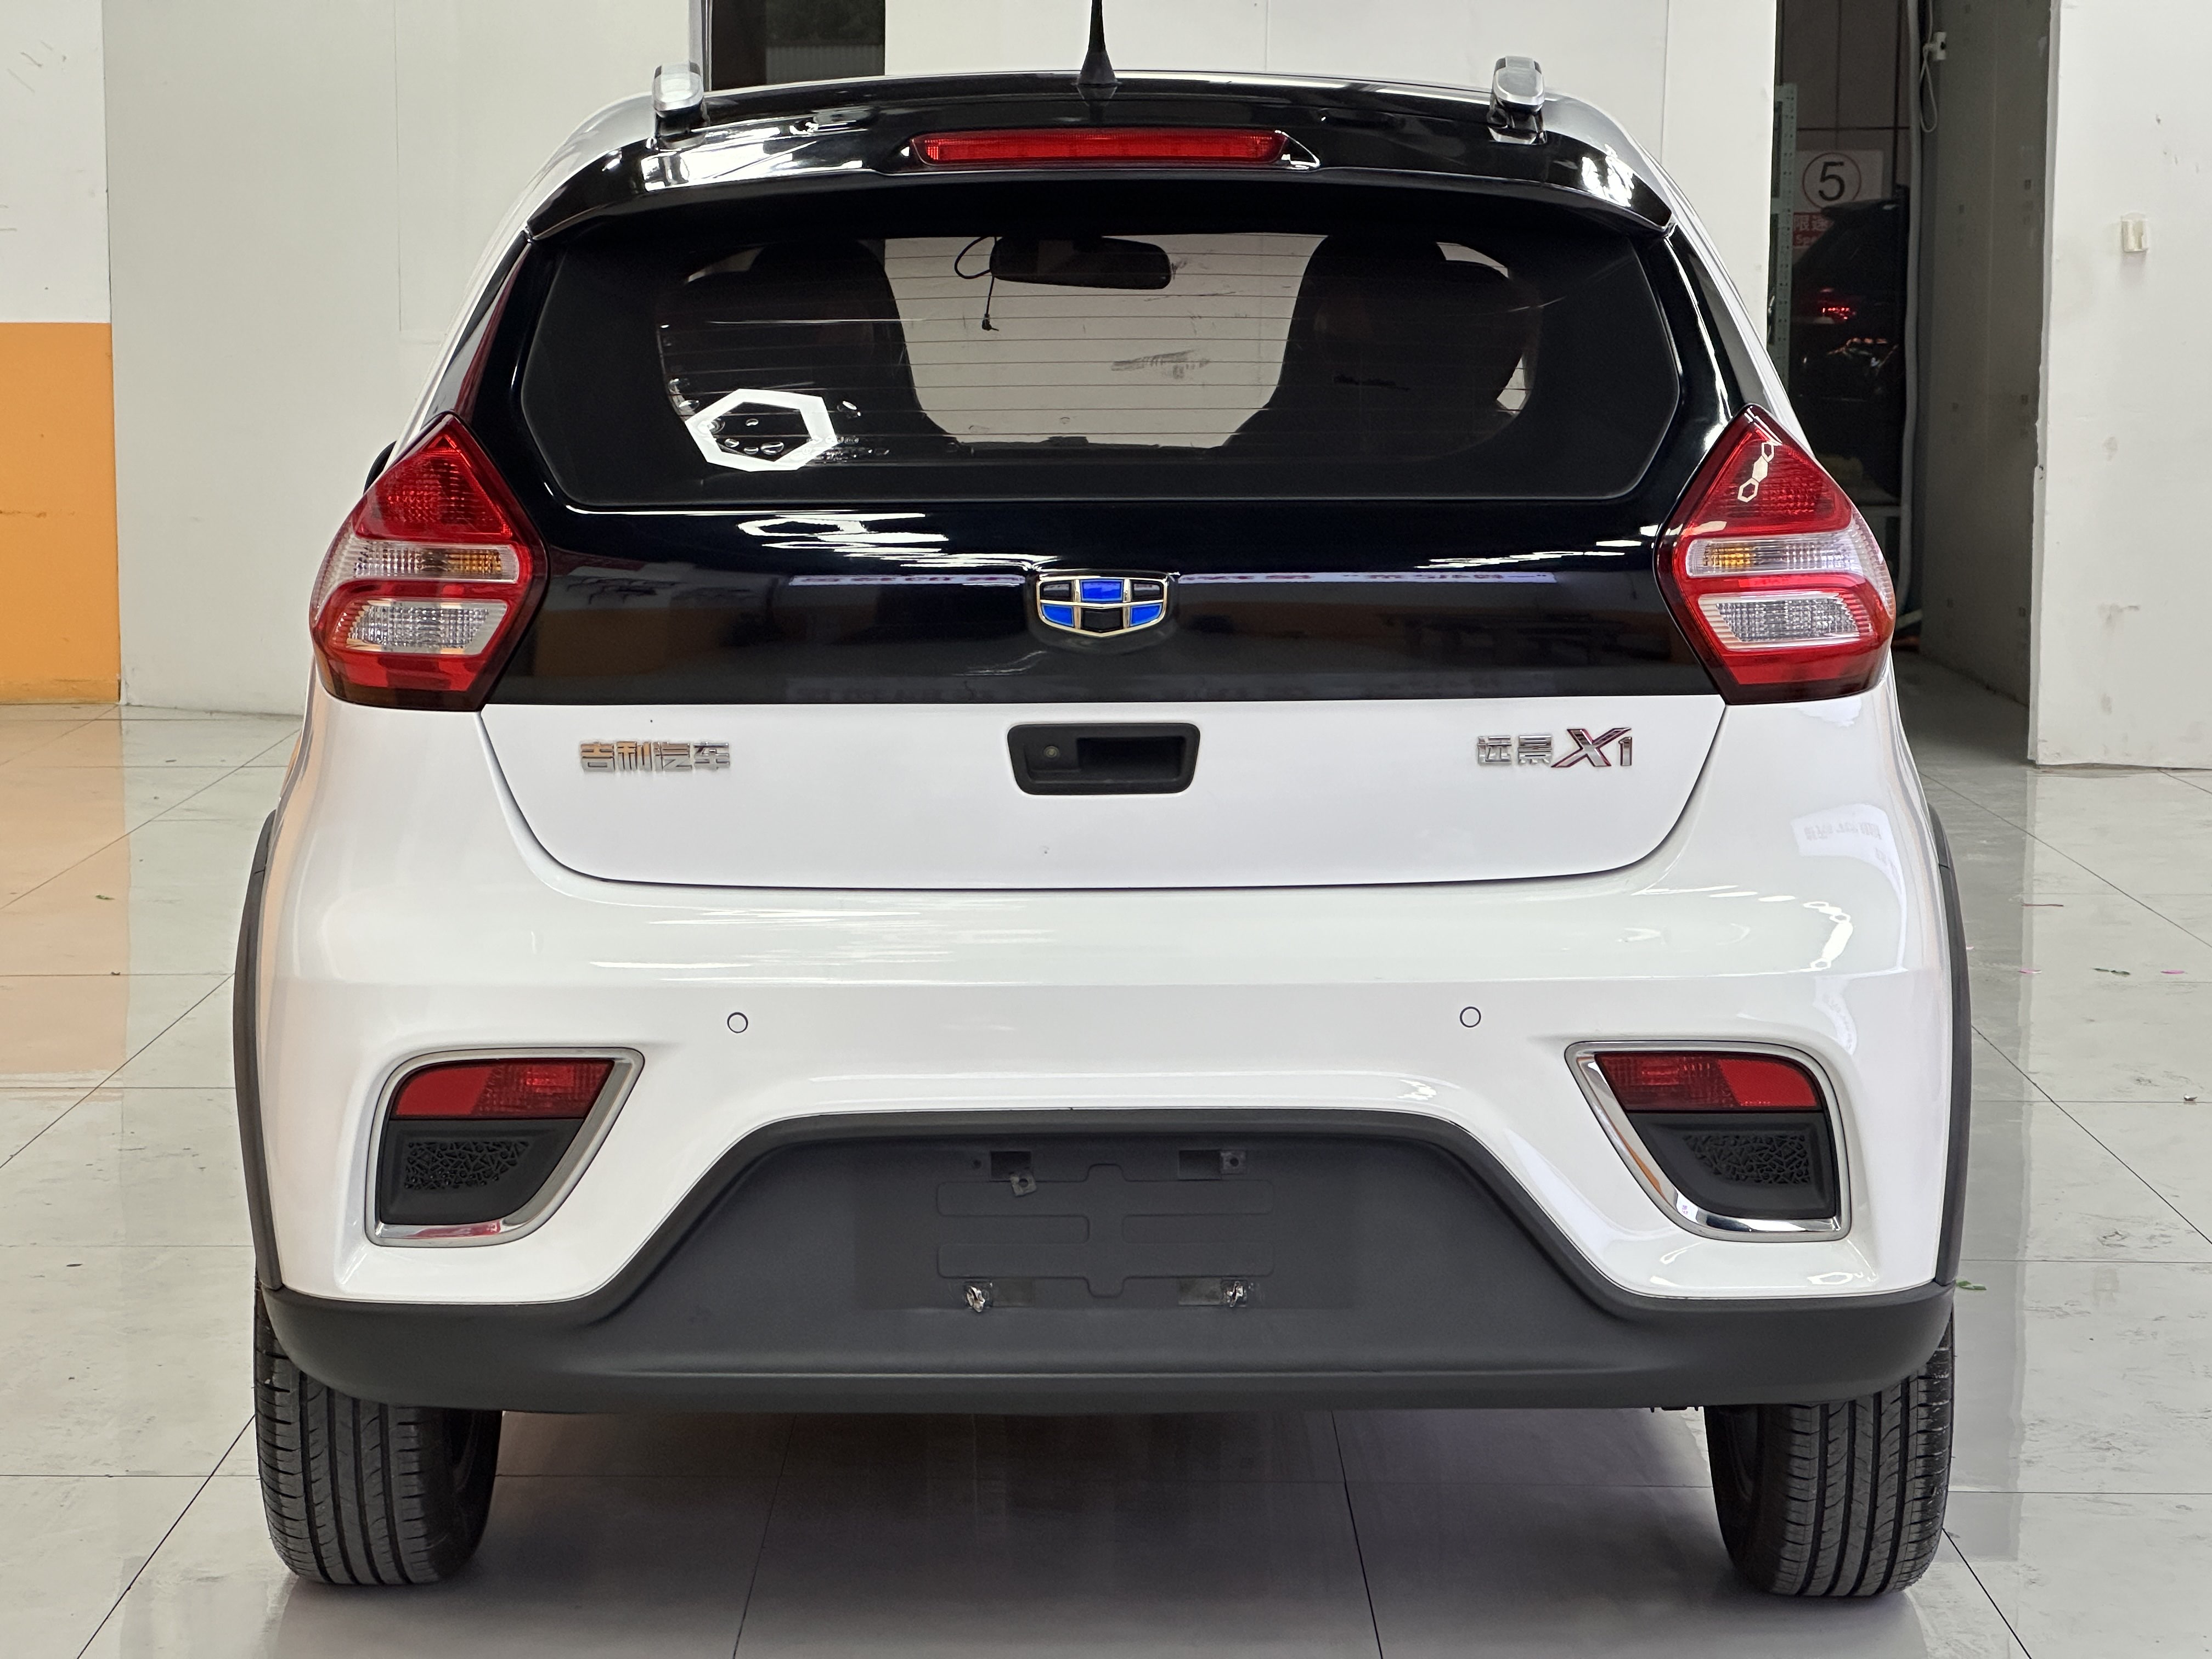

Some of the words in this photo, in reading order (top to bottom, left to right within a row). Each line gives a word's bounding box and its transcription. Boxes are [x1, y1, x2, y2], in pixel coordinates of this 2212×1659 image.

[1818, 161, 1845, 201] 5
[580, 741, 730, 771] 吉利汽车
